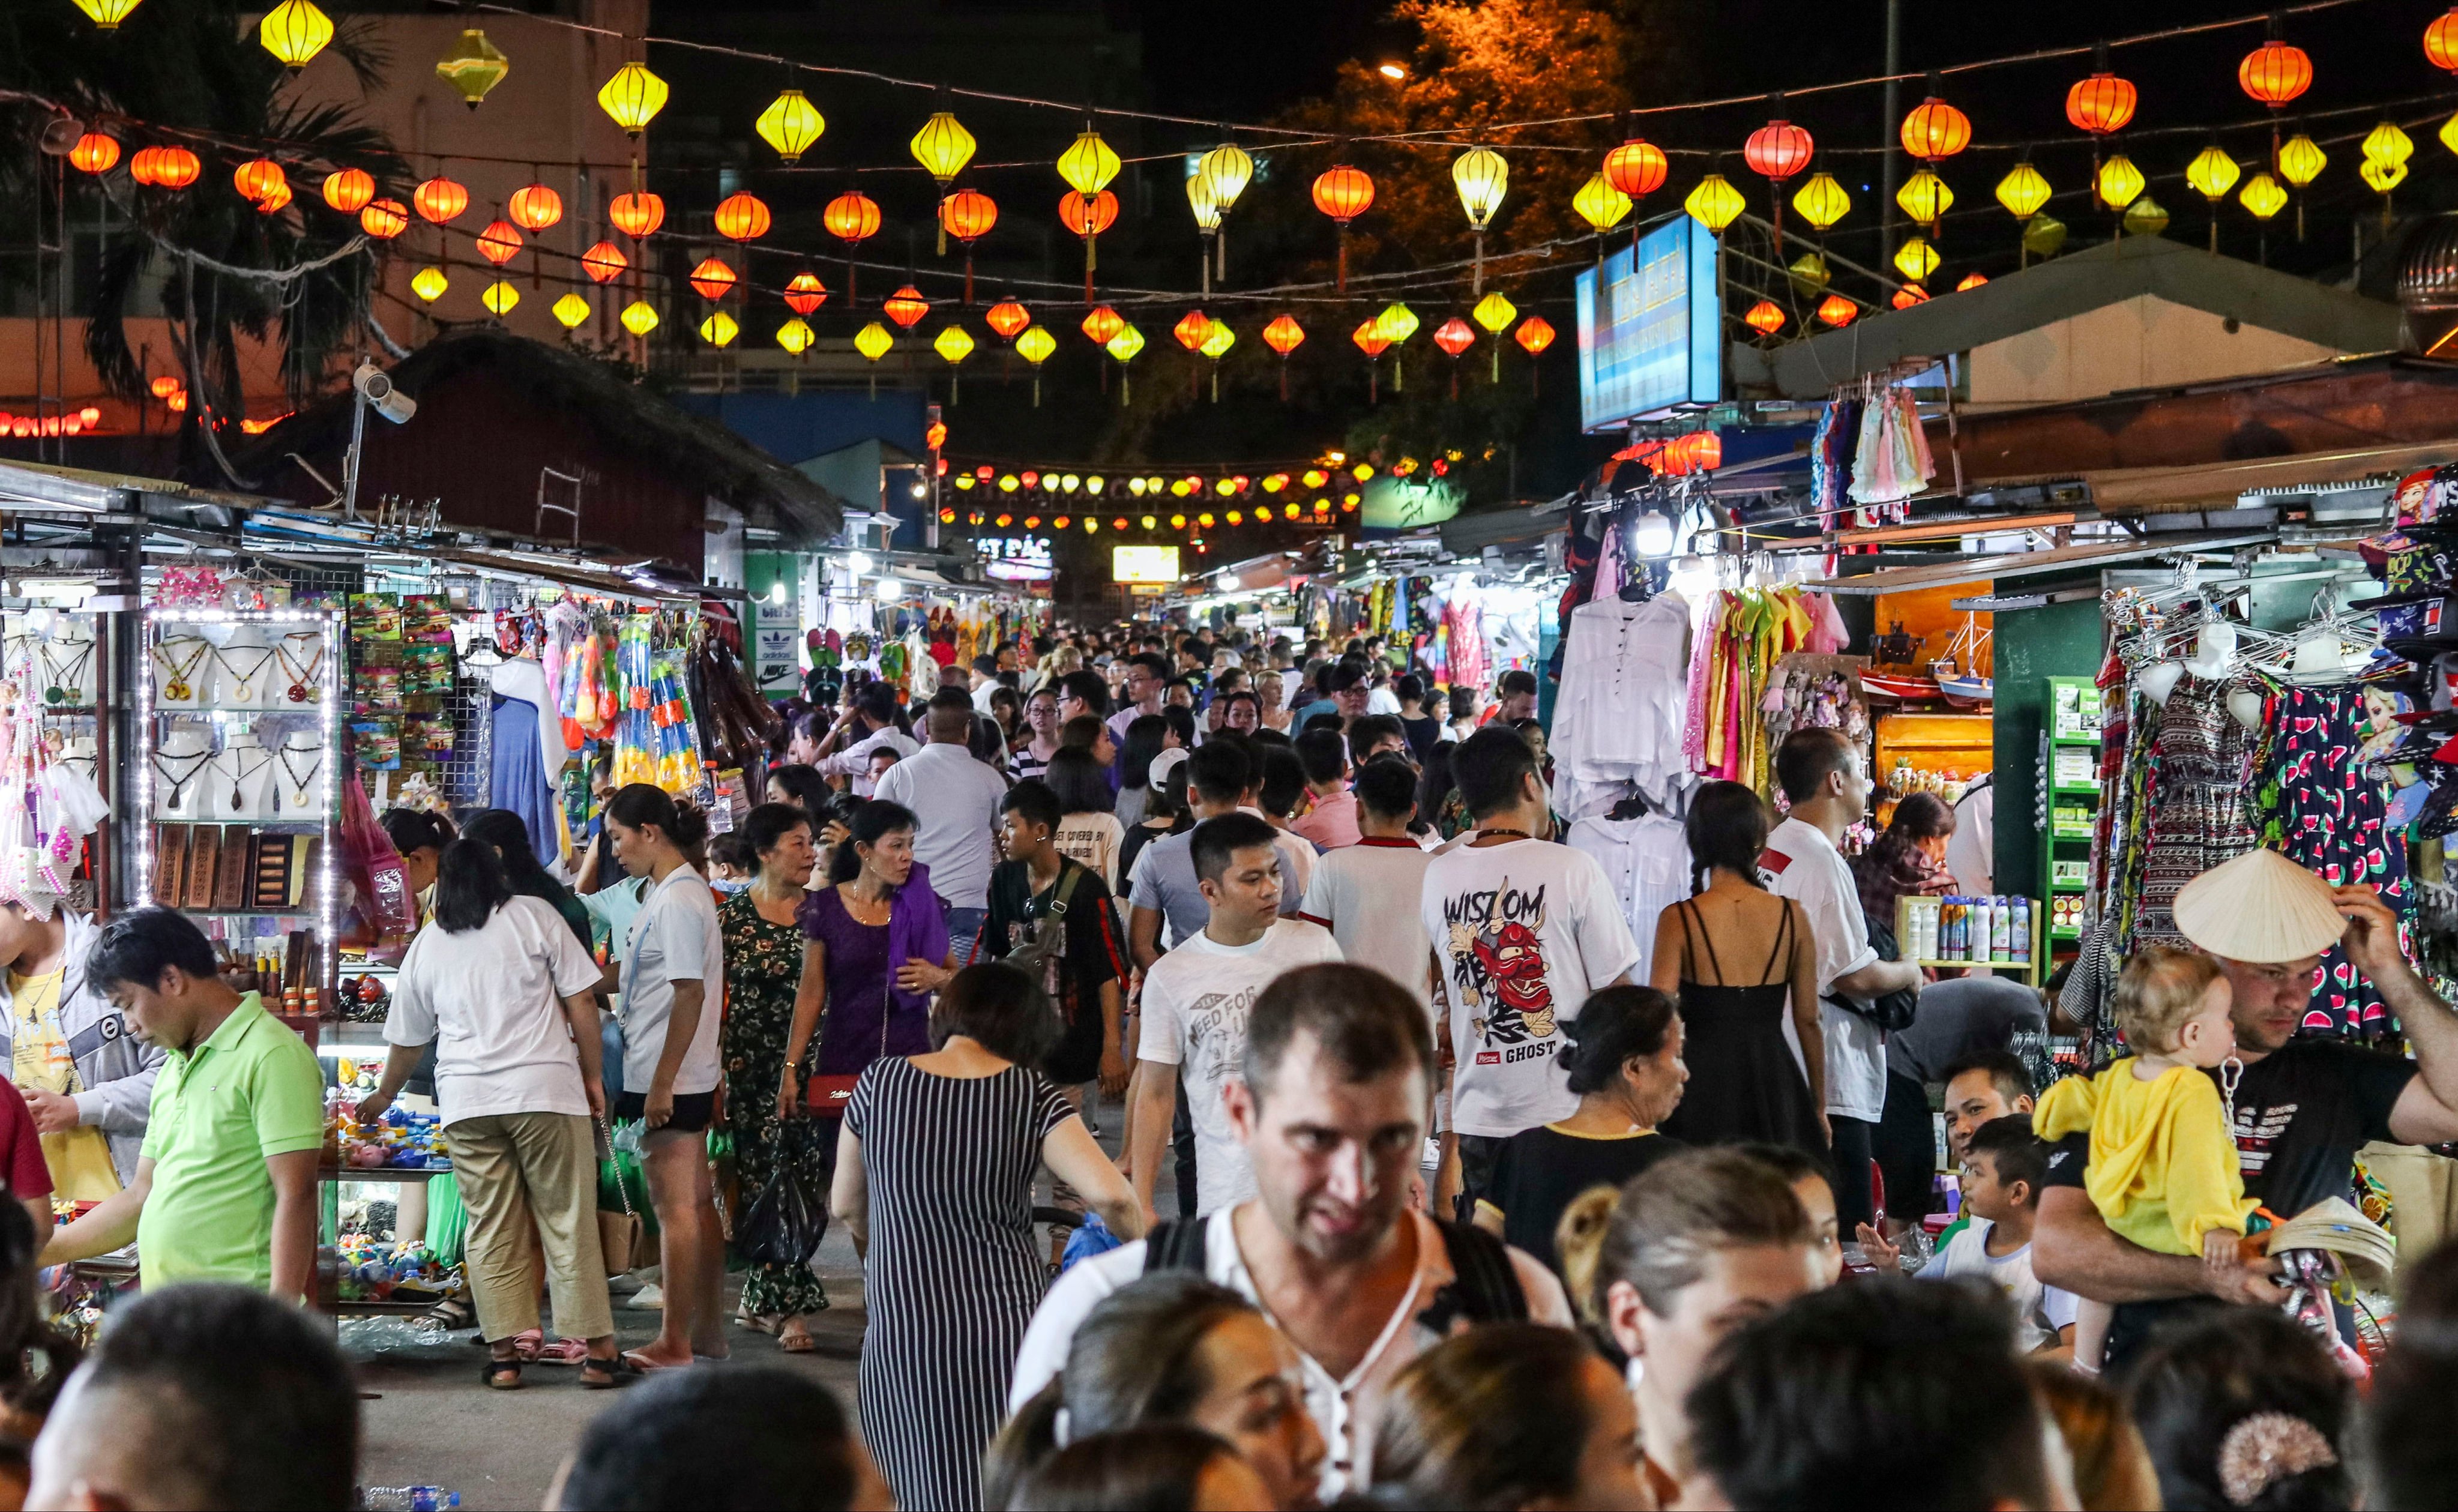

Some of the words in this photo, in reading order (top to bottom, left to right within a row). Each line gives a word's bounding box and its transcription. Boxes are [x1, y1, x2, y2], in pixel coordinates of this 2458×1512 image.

[764, 664, 789, 676] NIKE
[1095, 831, 1105, 842] BY
[1188, 1009, 1221, 1048] NEED
[1224, 986, 1257, 1016] FOR
[1506, 1040, 1556, 1063] GHOST
